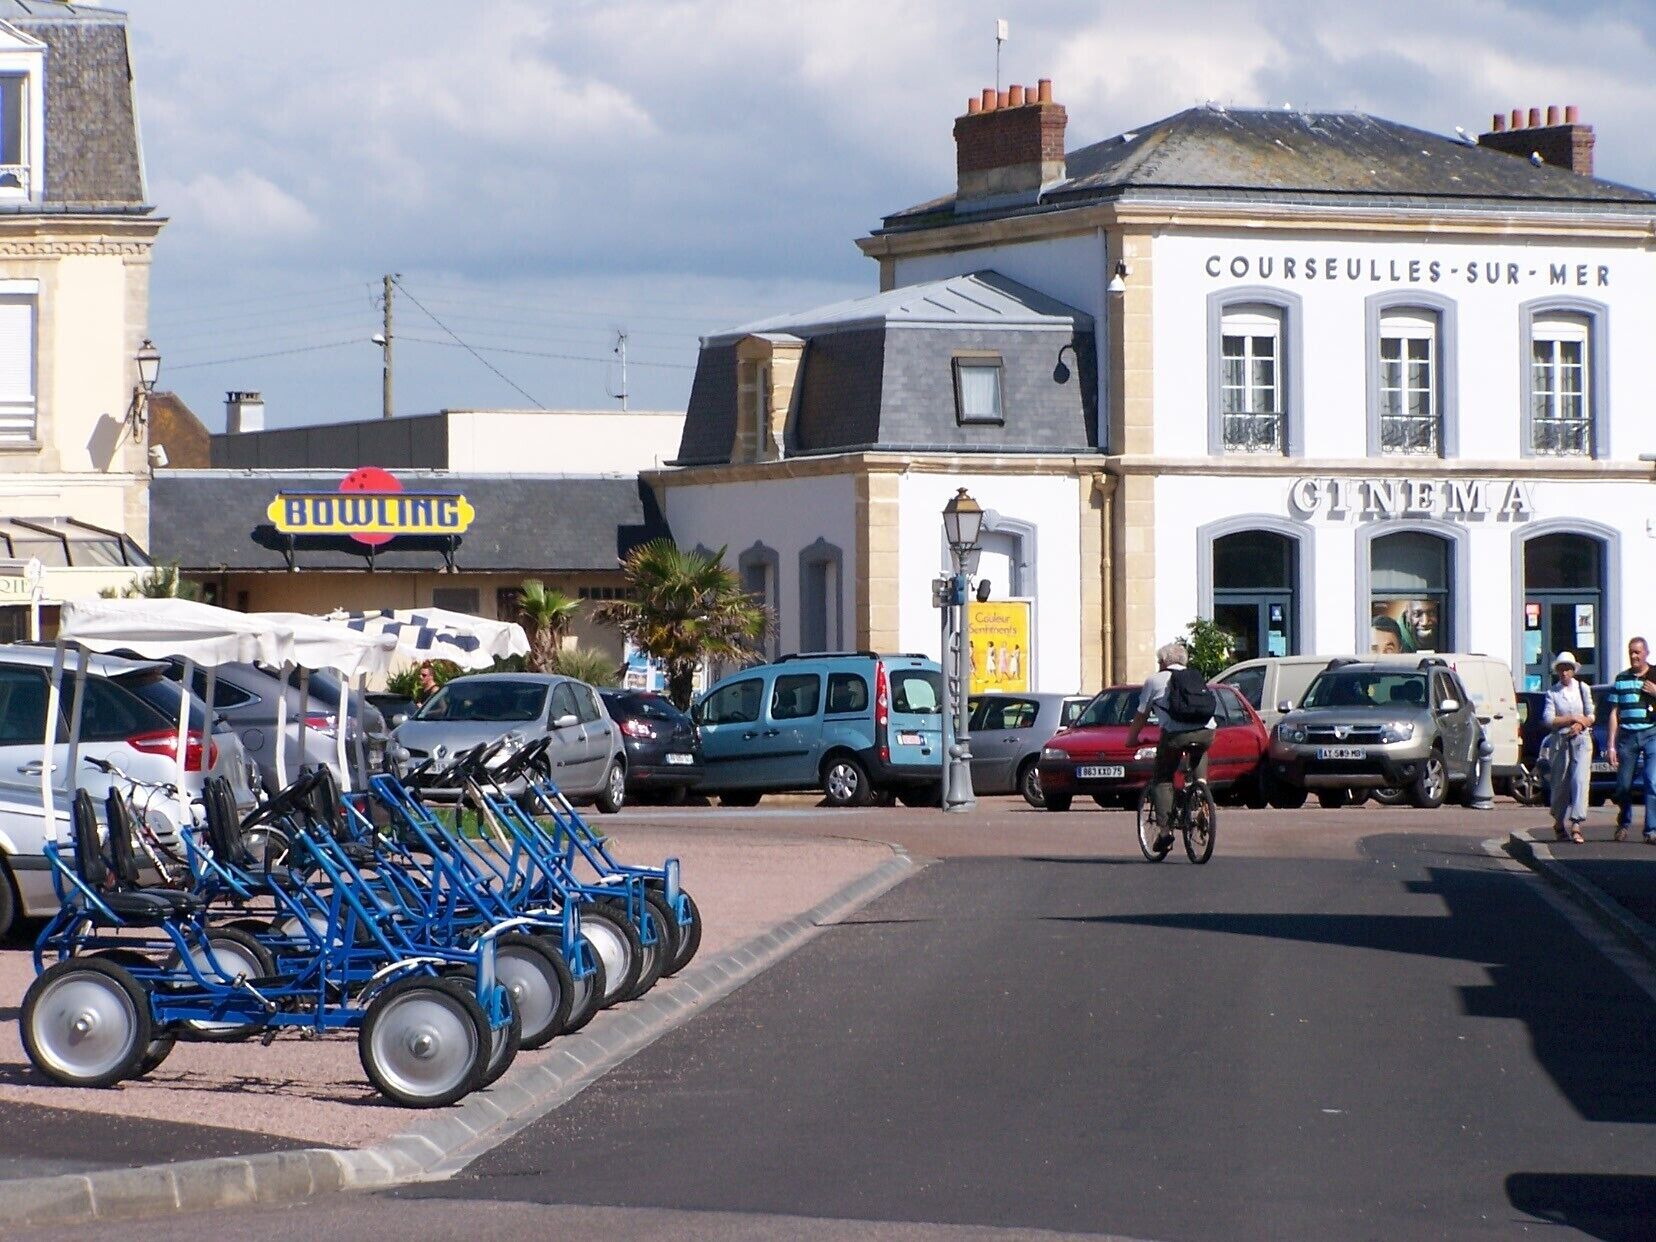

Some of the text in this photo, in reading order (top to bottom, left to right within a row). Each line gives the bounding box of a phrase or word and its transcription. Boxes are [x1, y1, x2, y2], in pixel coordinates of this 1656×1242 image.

[1205, 255, 1610, 287] COURSEULLES-SUR-MER
[284, 497, 460, 527] BOWLING
[1288, 478, 1536, 521] CINEMA
[969, 623, 1018, 635] Sentiments
[975, 612, 1011, 624] Couleur
